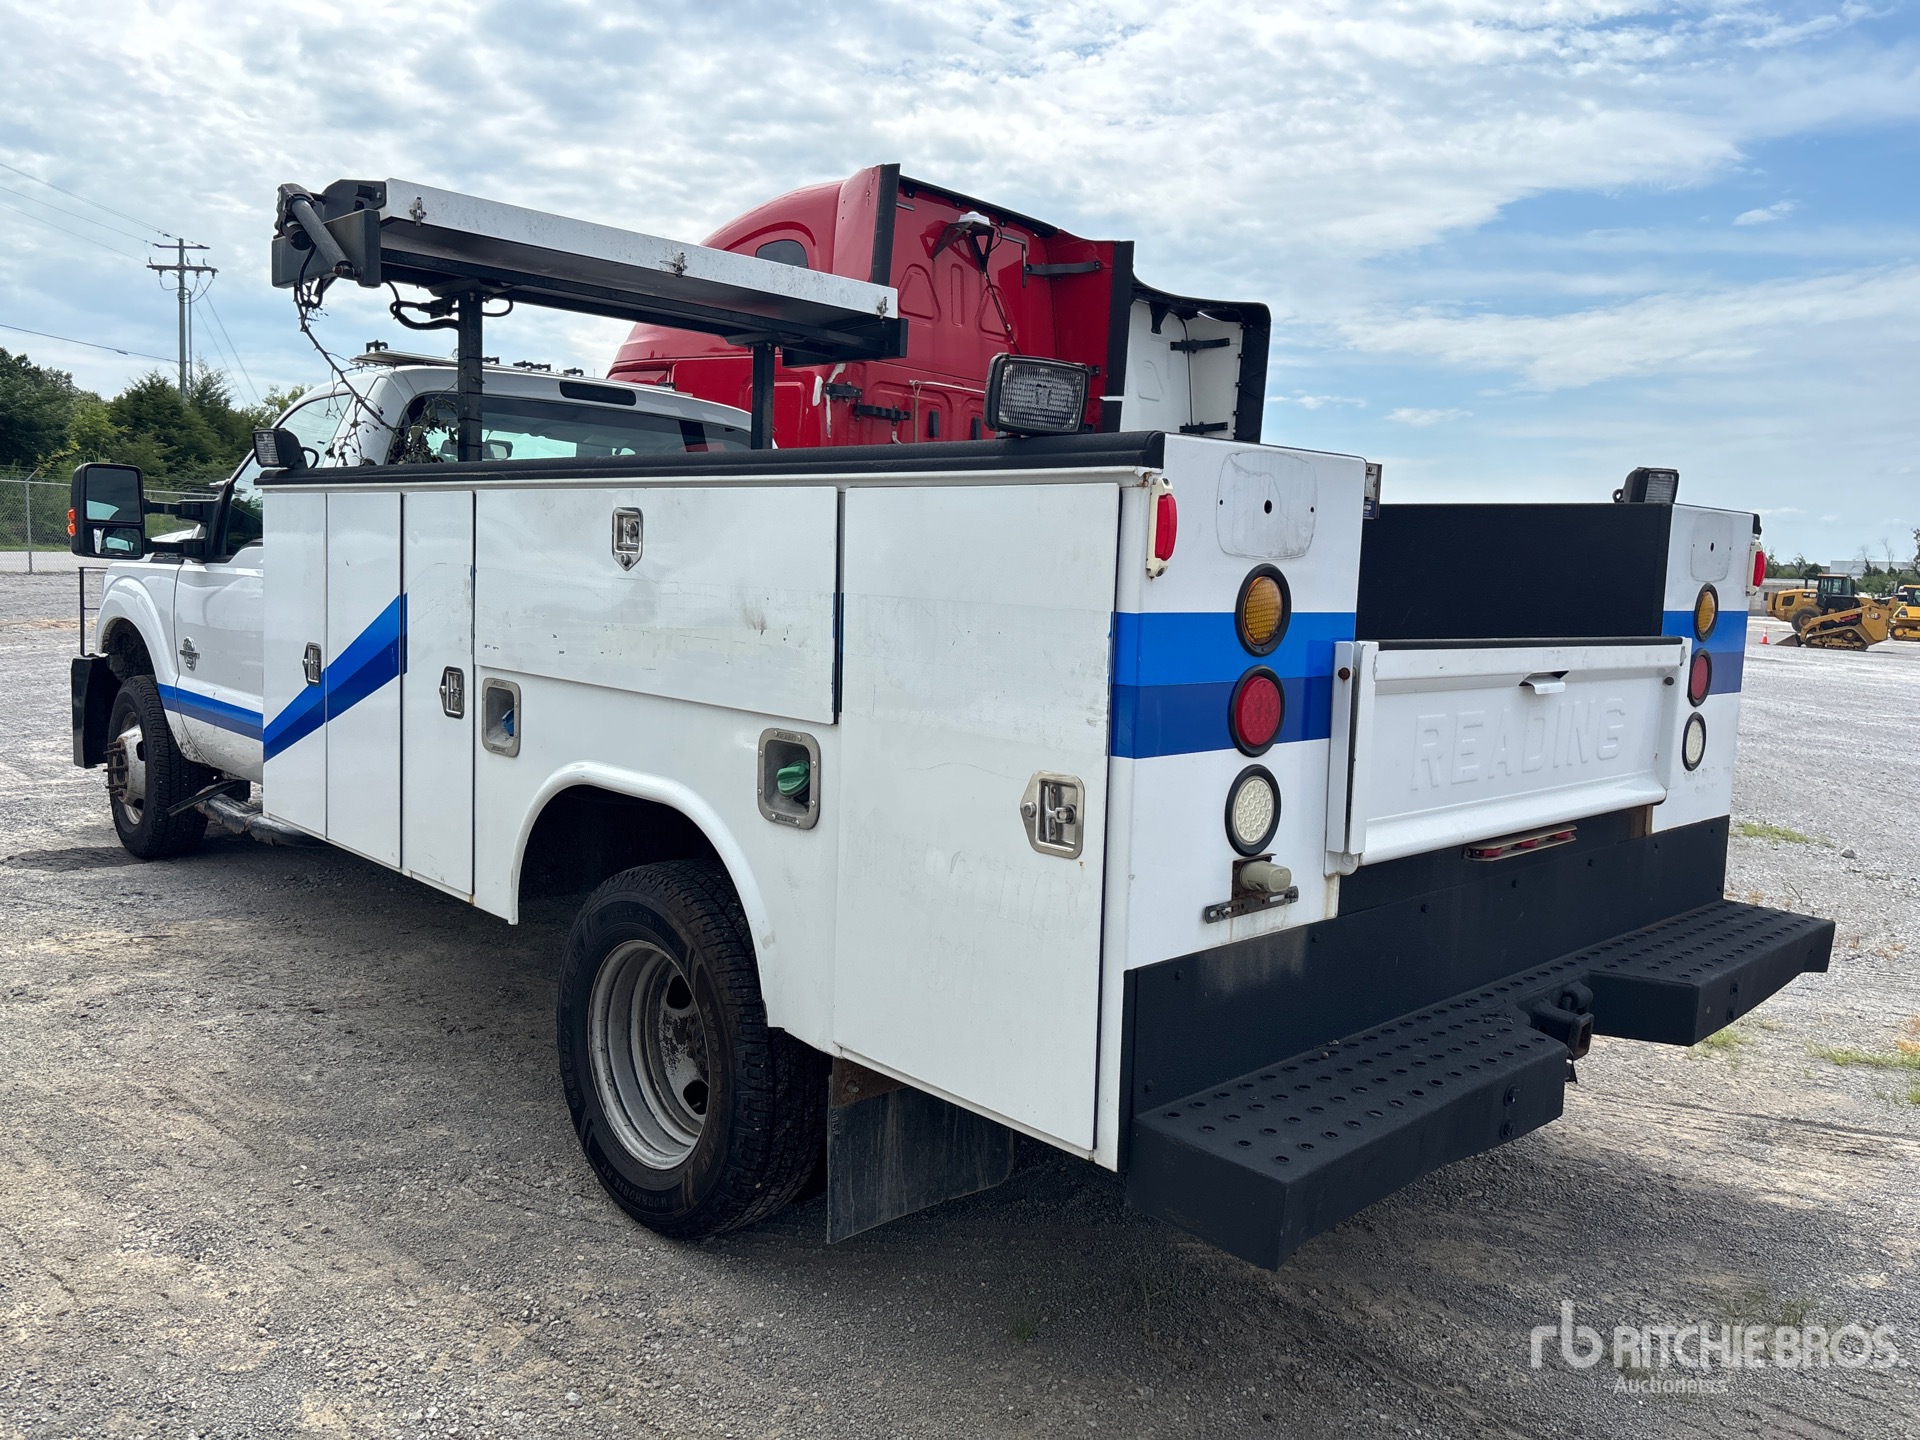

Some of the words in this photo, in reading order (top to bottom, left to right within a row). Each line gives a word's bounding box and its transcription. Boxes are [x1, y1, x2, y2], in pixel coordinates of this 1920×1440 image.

[1411, 698, 1626, 791] READING
[600, 1164, 613, 1180] HT
[613, 1177, 668, 1208] WORKHORSE
